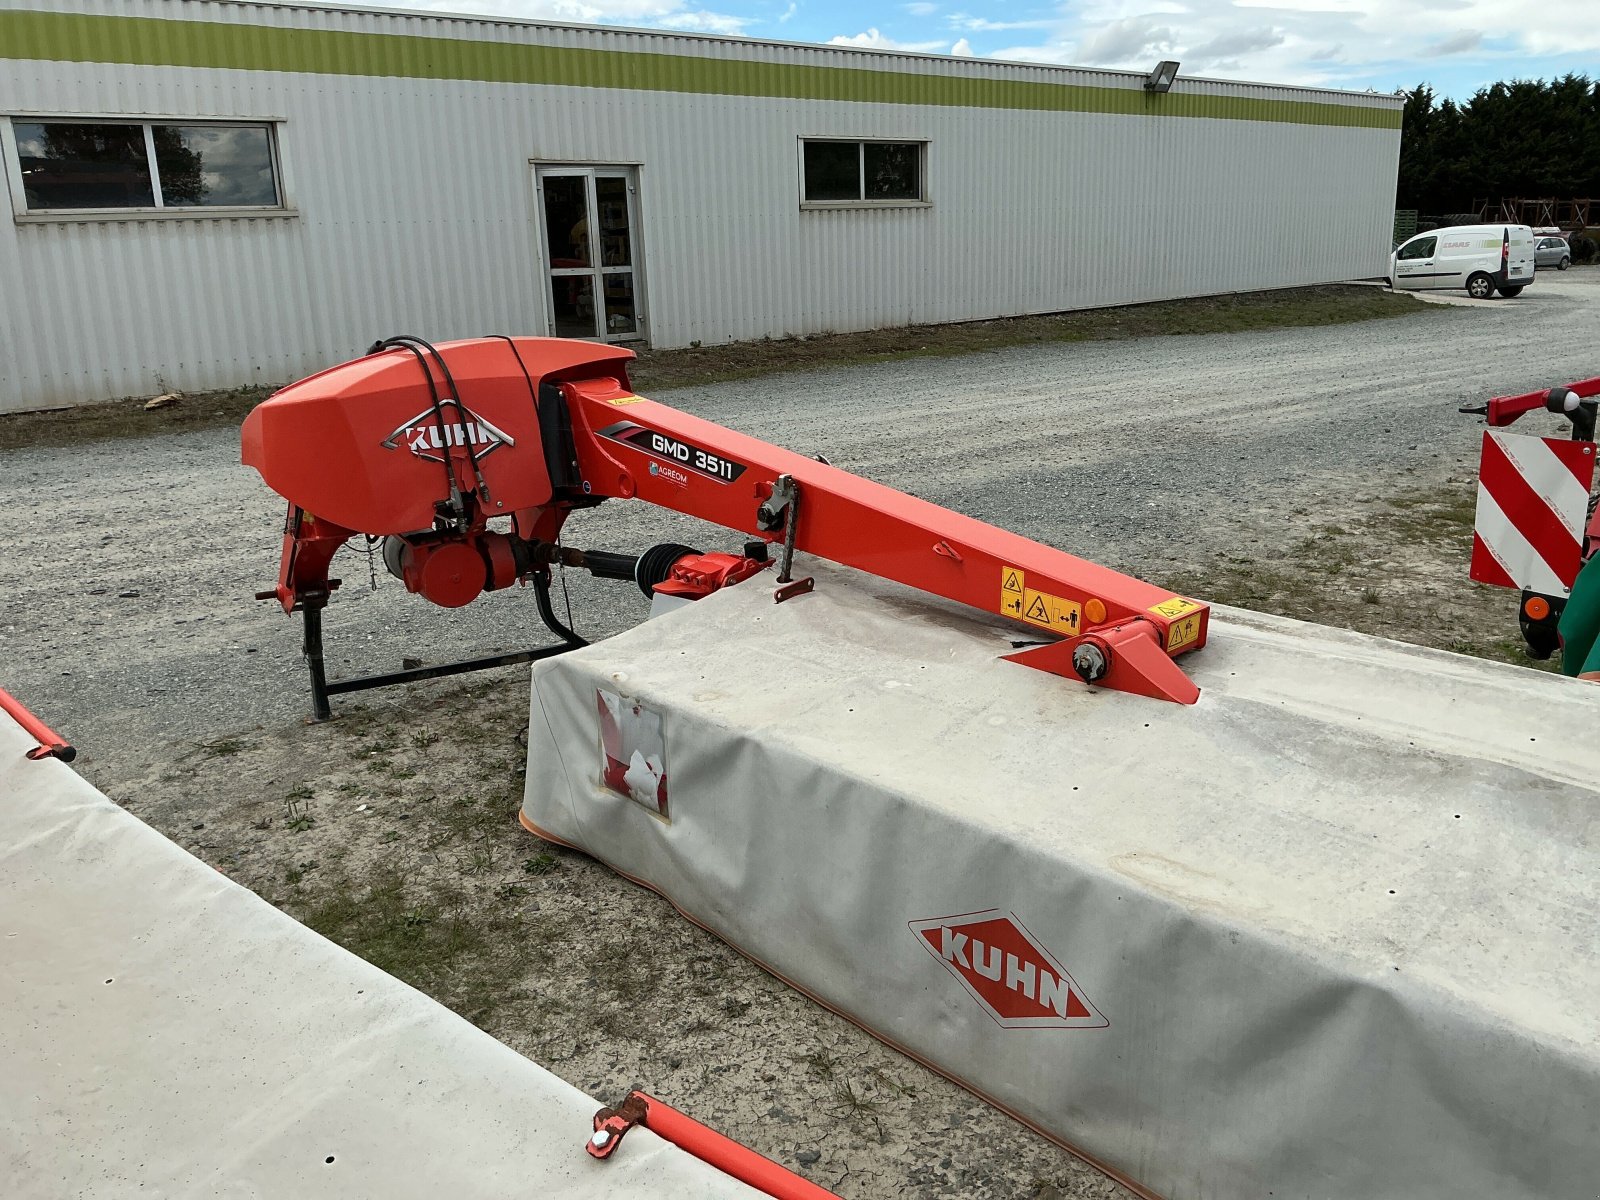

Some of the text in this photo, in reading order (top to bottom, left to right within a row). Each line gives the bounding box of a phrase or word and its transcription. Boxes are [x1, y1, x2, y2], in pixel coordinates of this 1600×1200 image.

[652, 433, 732, 479] GMD 3511
[941, 924, 1070, 1020] KUHN
